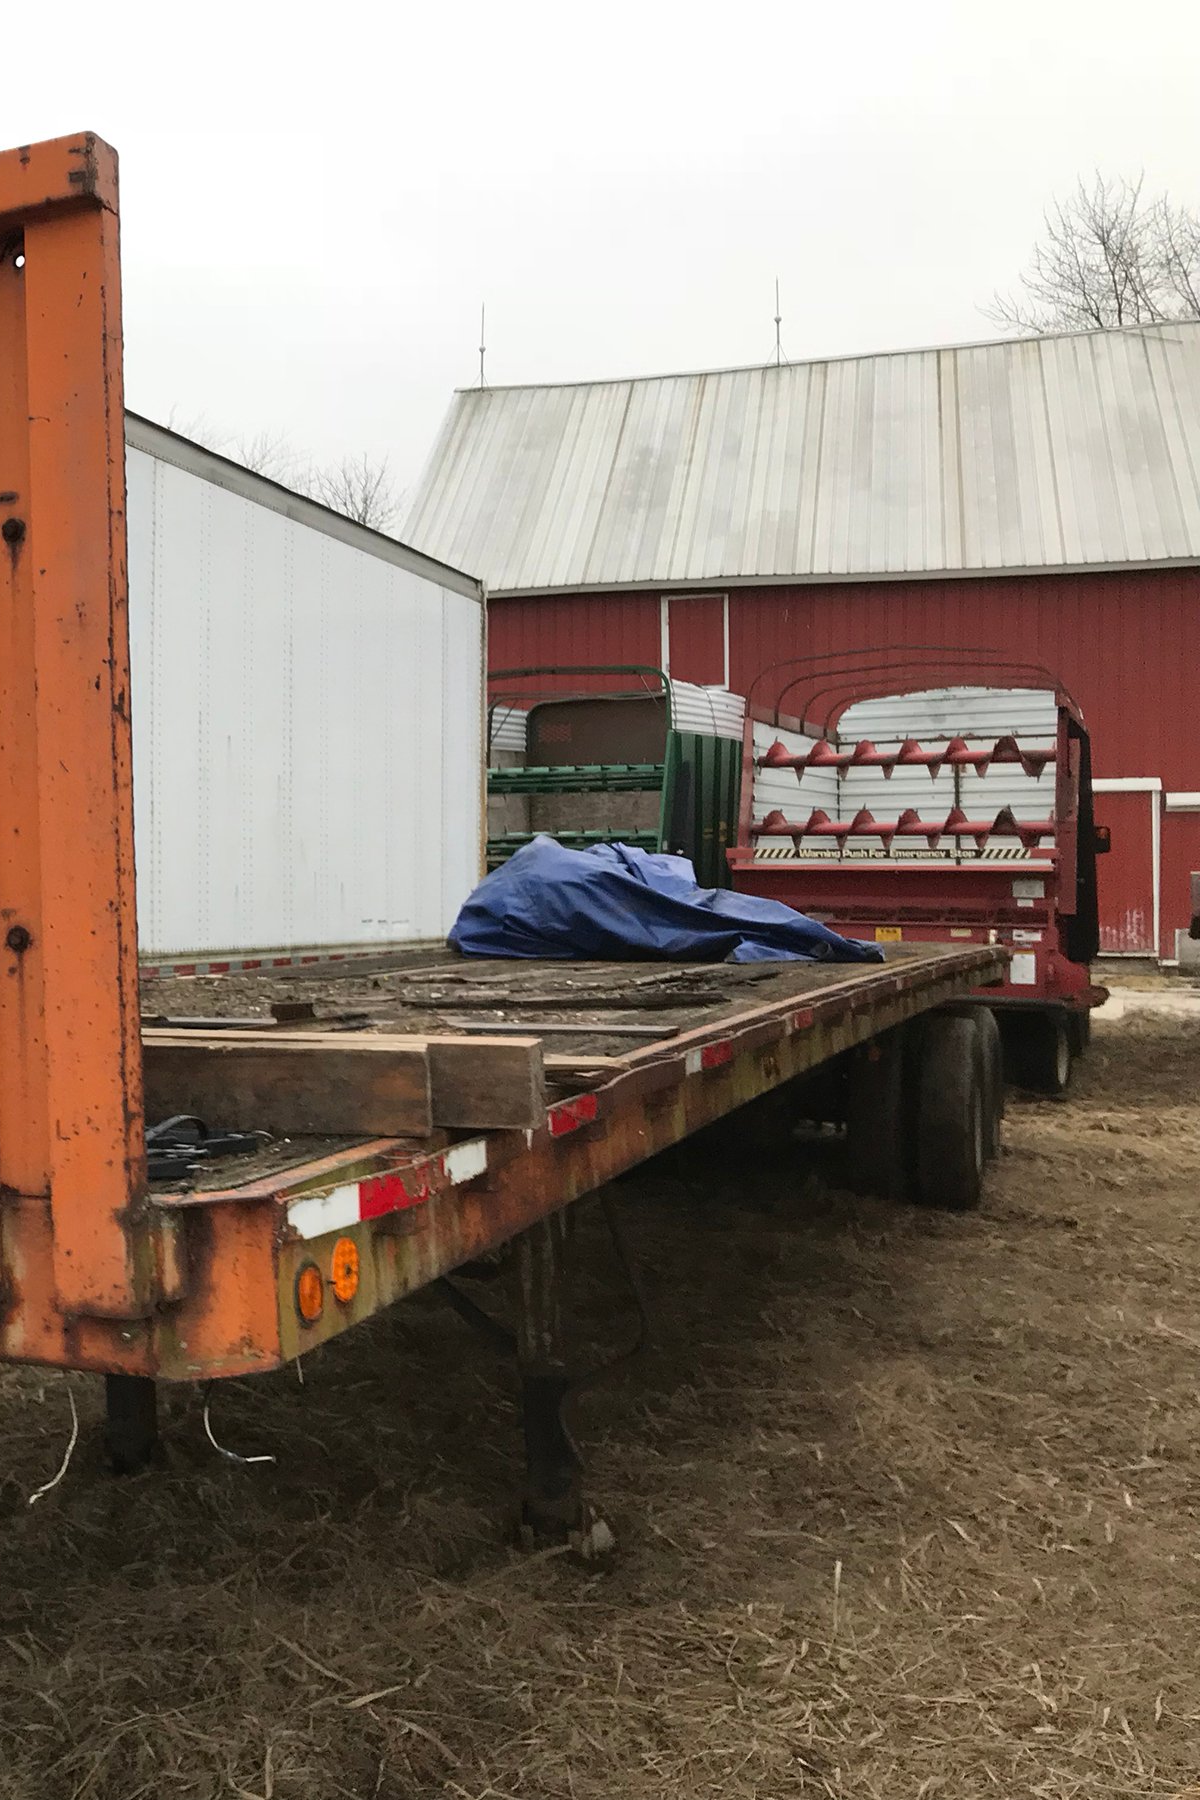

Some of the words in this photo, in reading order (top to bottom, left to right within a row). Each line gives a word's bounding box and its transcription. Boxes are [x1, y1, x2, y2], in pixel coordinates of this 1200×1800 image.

[800, 848, 840, 859] Warning
[842, 848, 867, 859] Push
[869, 848, 887, 859] For
[889, 848, 946, 859] Emergency
[949, 848, 976, 859] Stop
